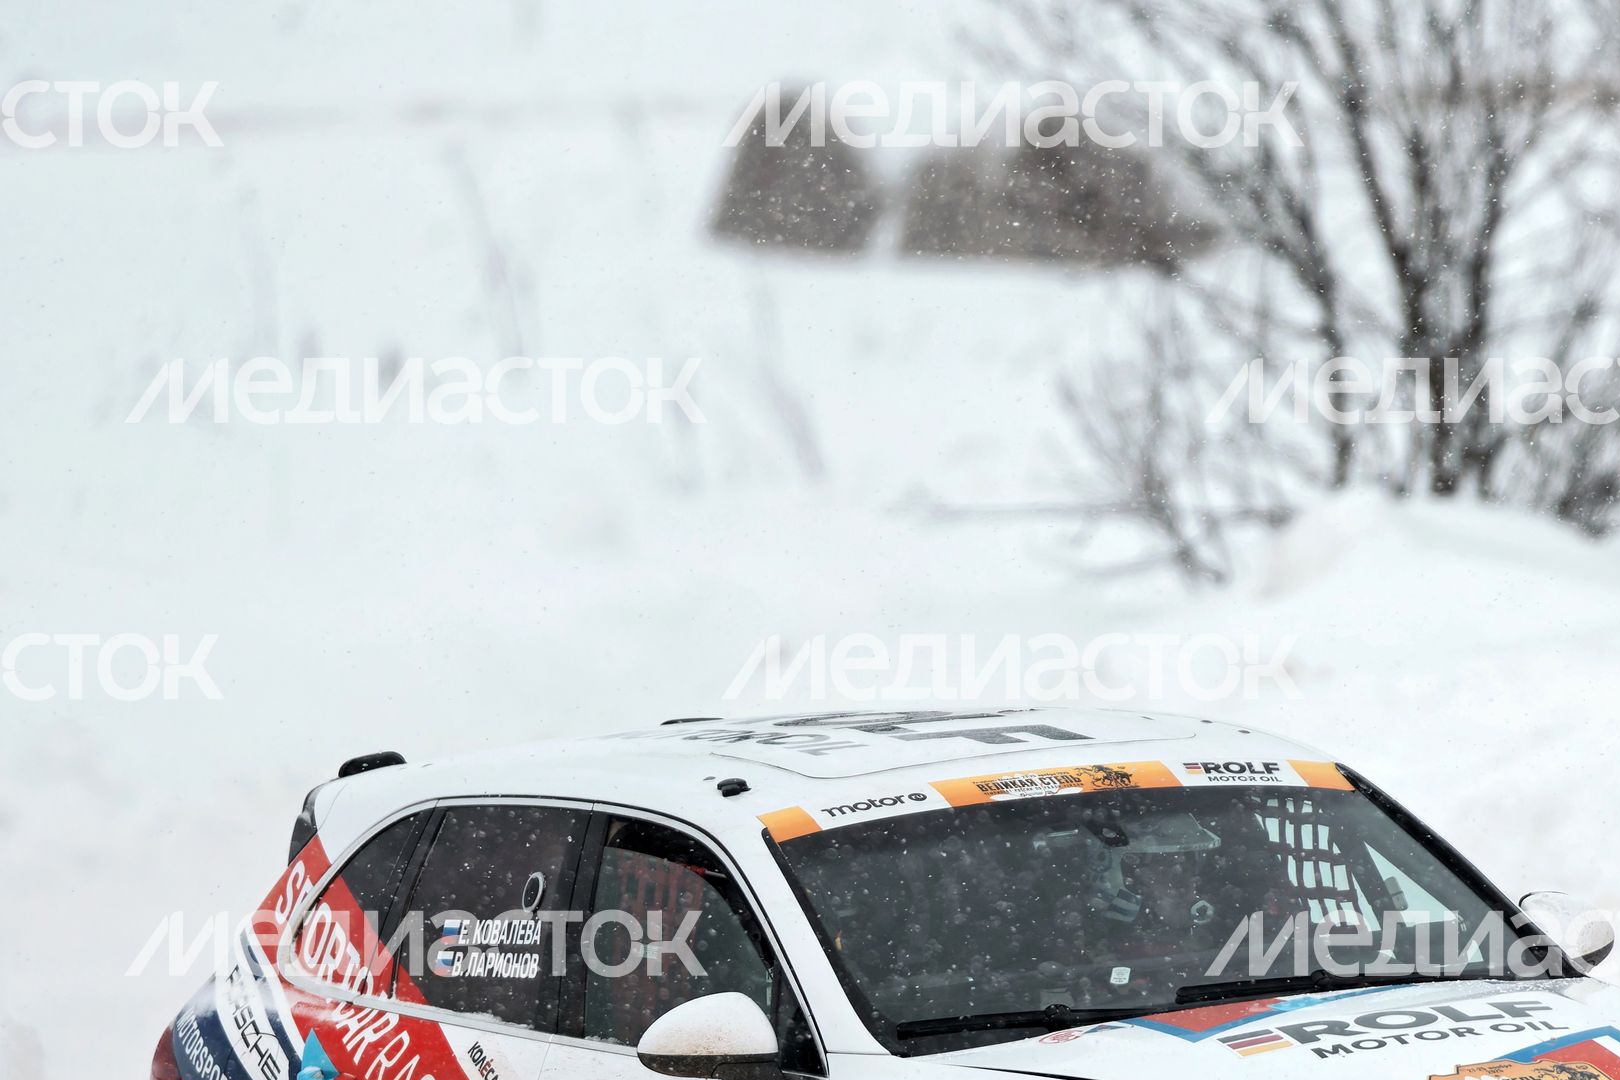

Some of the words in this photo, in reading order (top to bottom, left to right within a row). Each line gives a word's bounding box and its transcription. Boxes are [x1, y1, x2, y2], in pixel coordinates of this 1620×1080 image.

[1200, 762, 1280, 774] ROLF
[1259, 775, 1283, 783] OIL
[976, 778, 1038, 793] ВЕЛИКАЯ
[1038, 773, 1082, 786] СТЕПЬ
[472, 919, 542, 945] КОВАЛЕВА
[465, 951, 540, 979] ЛАРИОНОВ
[1275, 1000, 1553, 1045] ROLF
[1310, 1026, 1481, 1059] MOTOR
[1489, 1020, 1570, 1033] OIL
